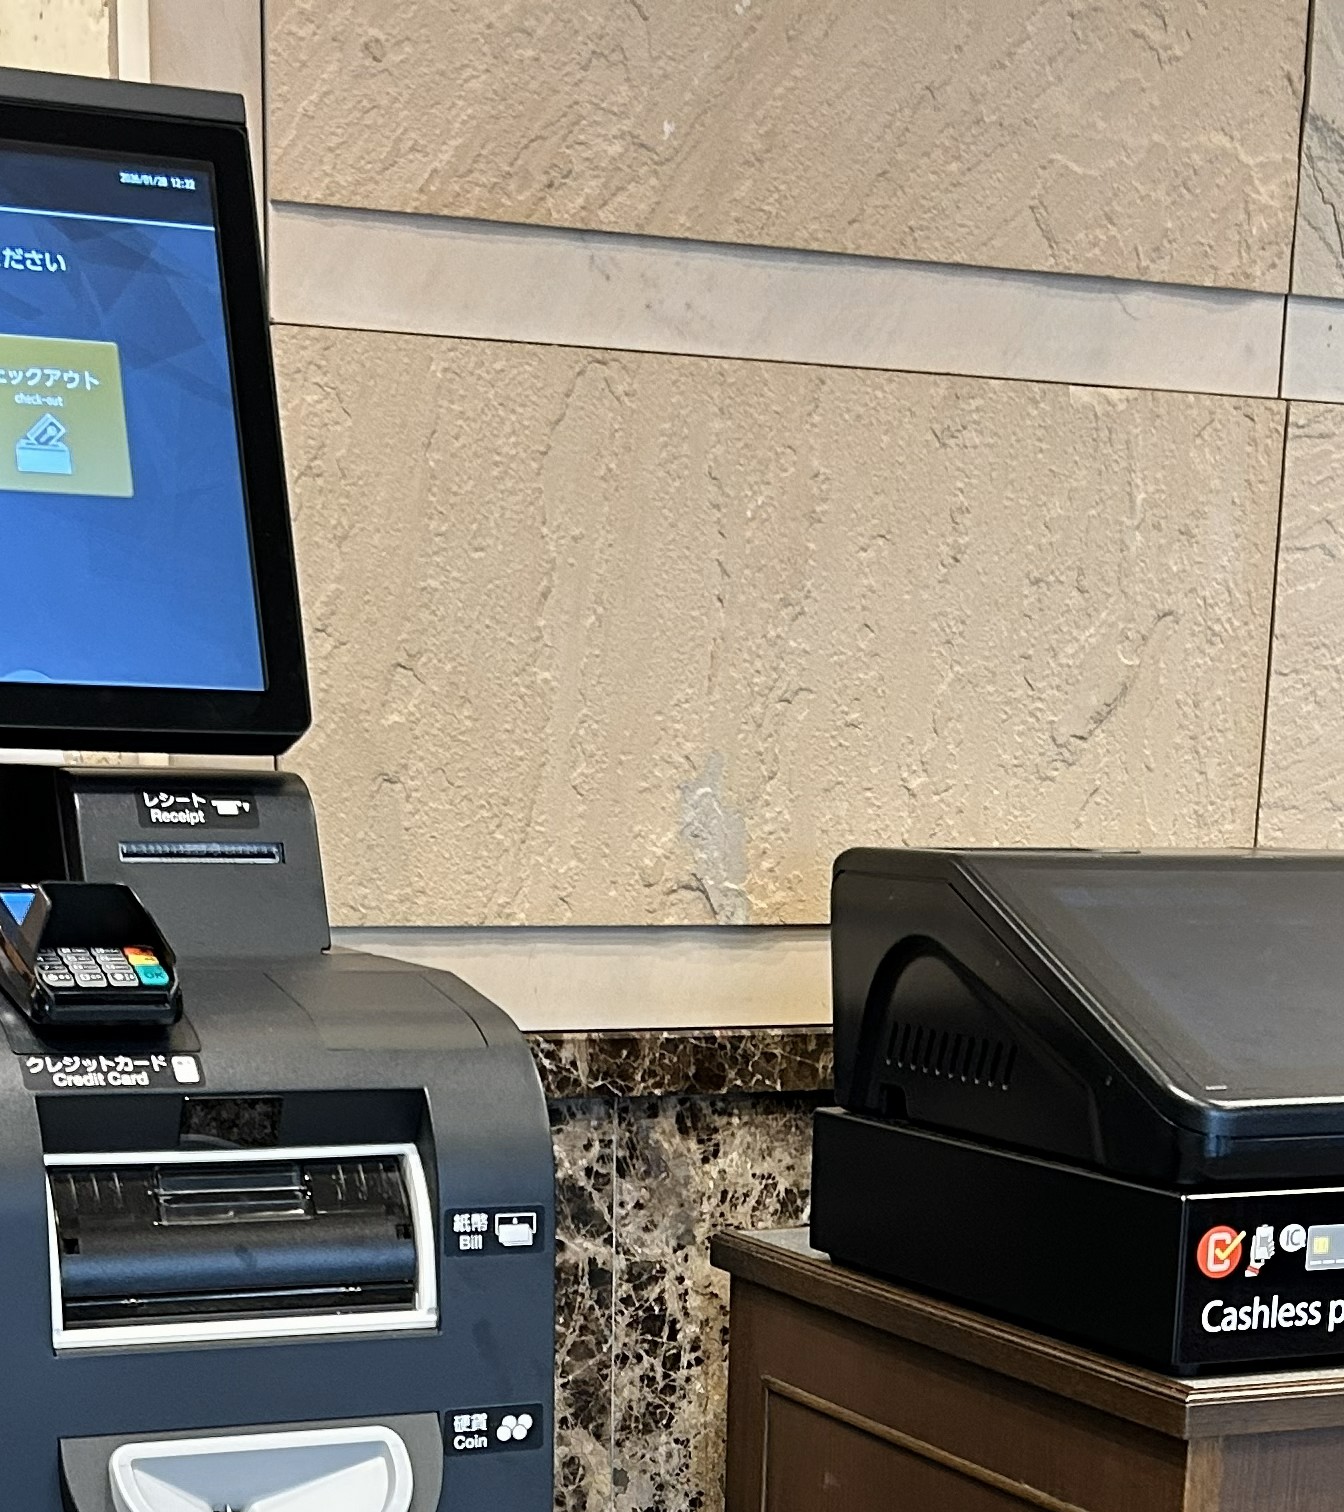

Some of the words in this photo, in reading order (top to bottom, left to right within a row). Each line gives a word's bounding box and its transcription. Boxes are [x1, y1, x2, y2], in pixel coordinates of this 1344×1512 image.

[142, 791, 206, 808] レシート
[150, 808, 205, 826] Receipt
[144, 969, 163, 980] OK
[26, 1054, 167, 1074] クレジットカード
[52, 1072, 106, 1087] Credit
[107, 1071, 150, 1086] Card
[459, 1234, 483, 1250] Bill
[1201, 1295, 1322, 1333] Cashless
[453, 1412, 488, 1433] 硬貨
[453, 1433, 488, 1450] Coin
